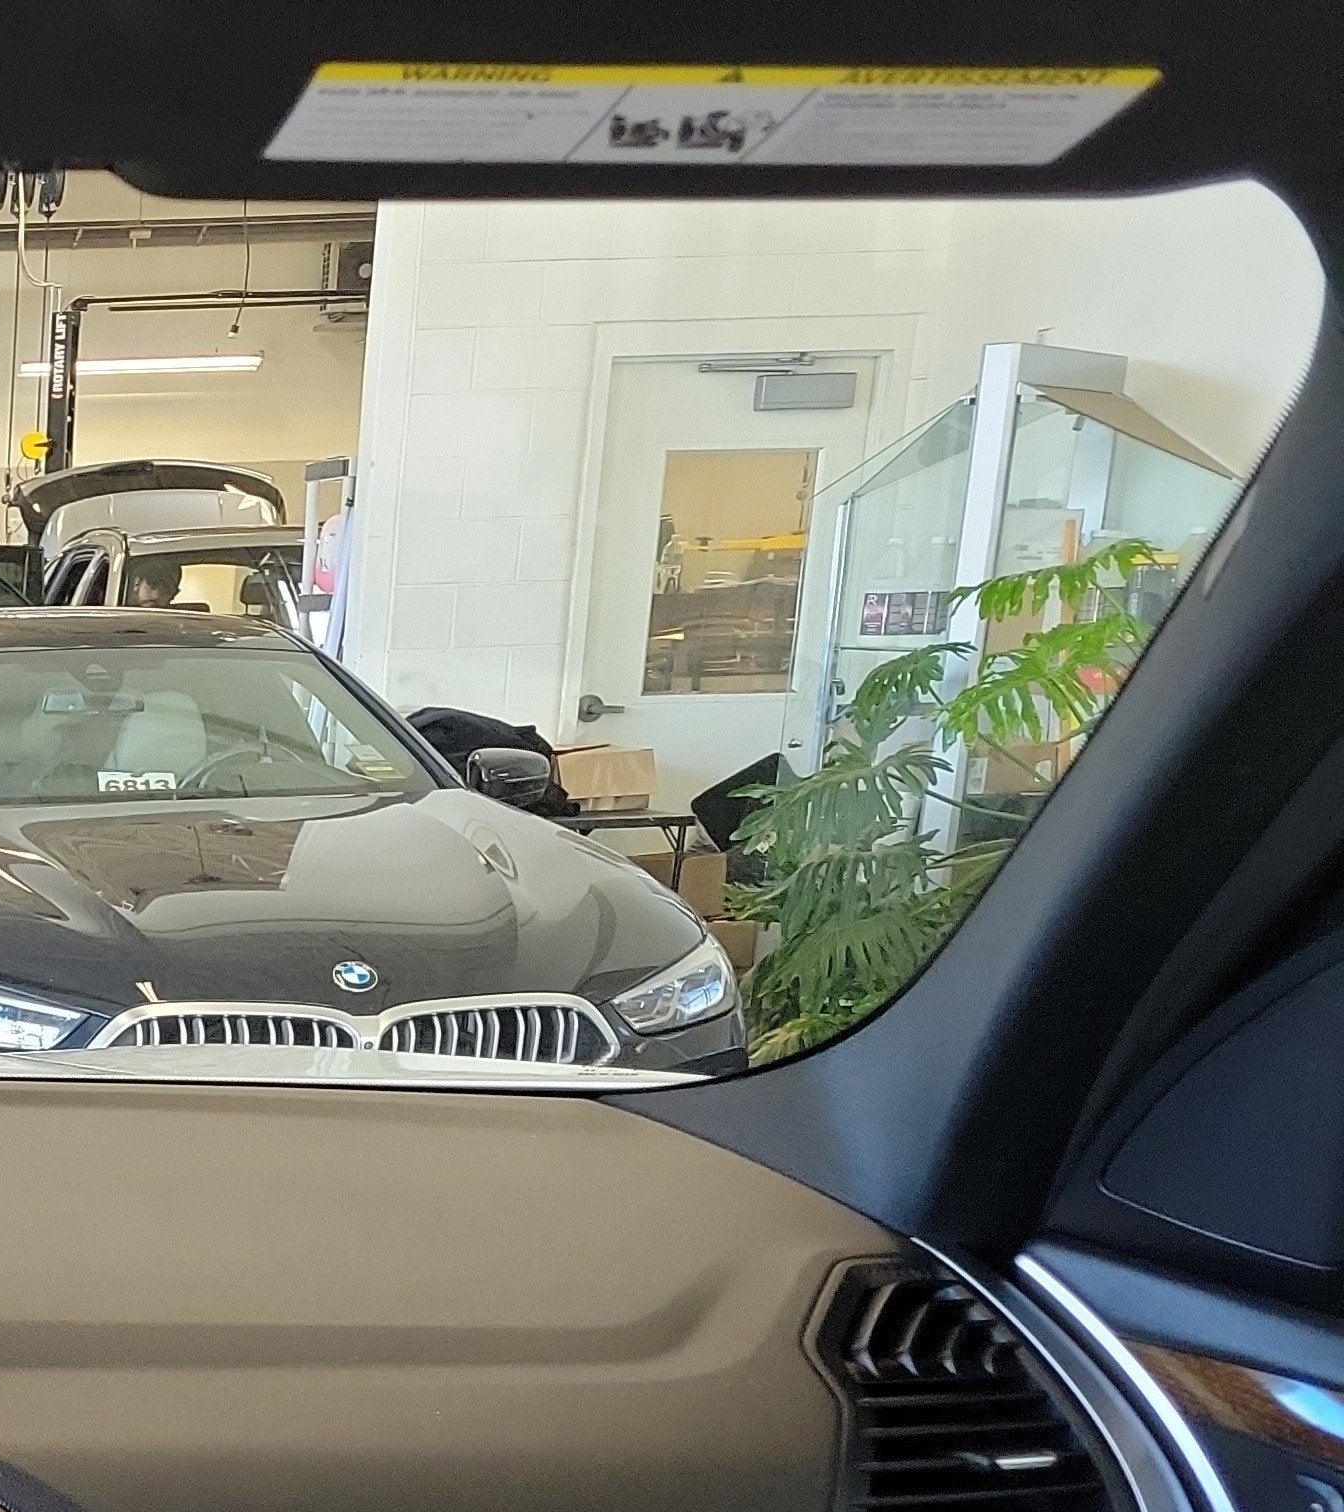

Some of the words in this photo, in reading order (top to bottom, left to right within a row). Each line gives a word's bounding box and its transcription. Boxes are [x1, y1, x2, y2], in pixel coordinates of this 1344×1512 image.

[401, 66, 551, 82] WARNING
[55, 313, 67, 340] LIFT
[52, 343, 65, 392] ROTARY
